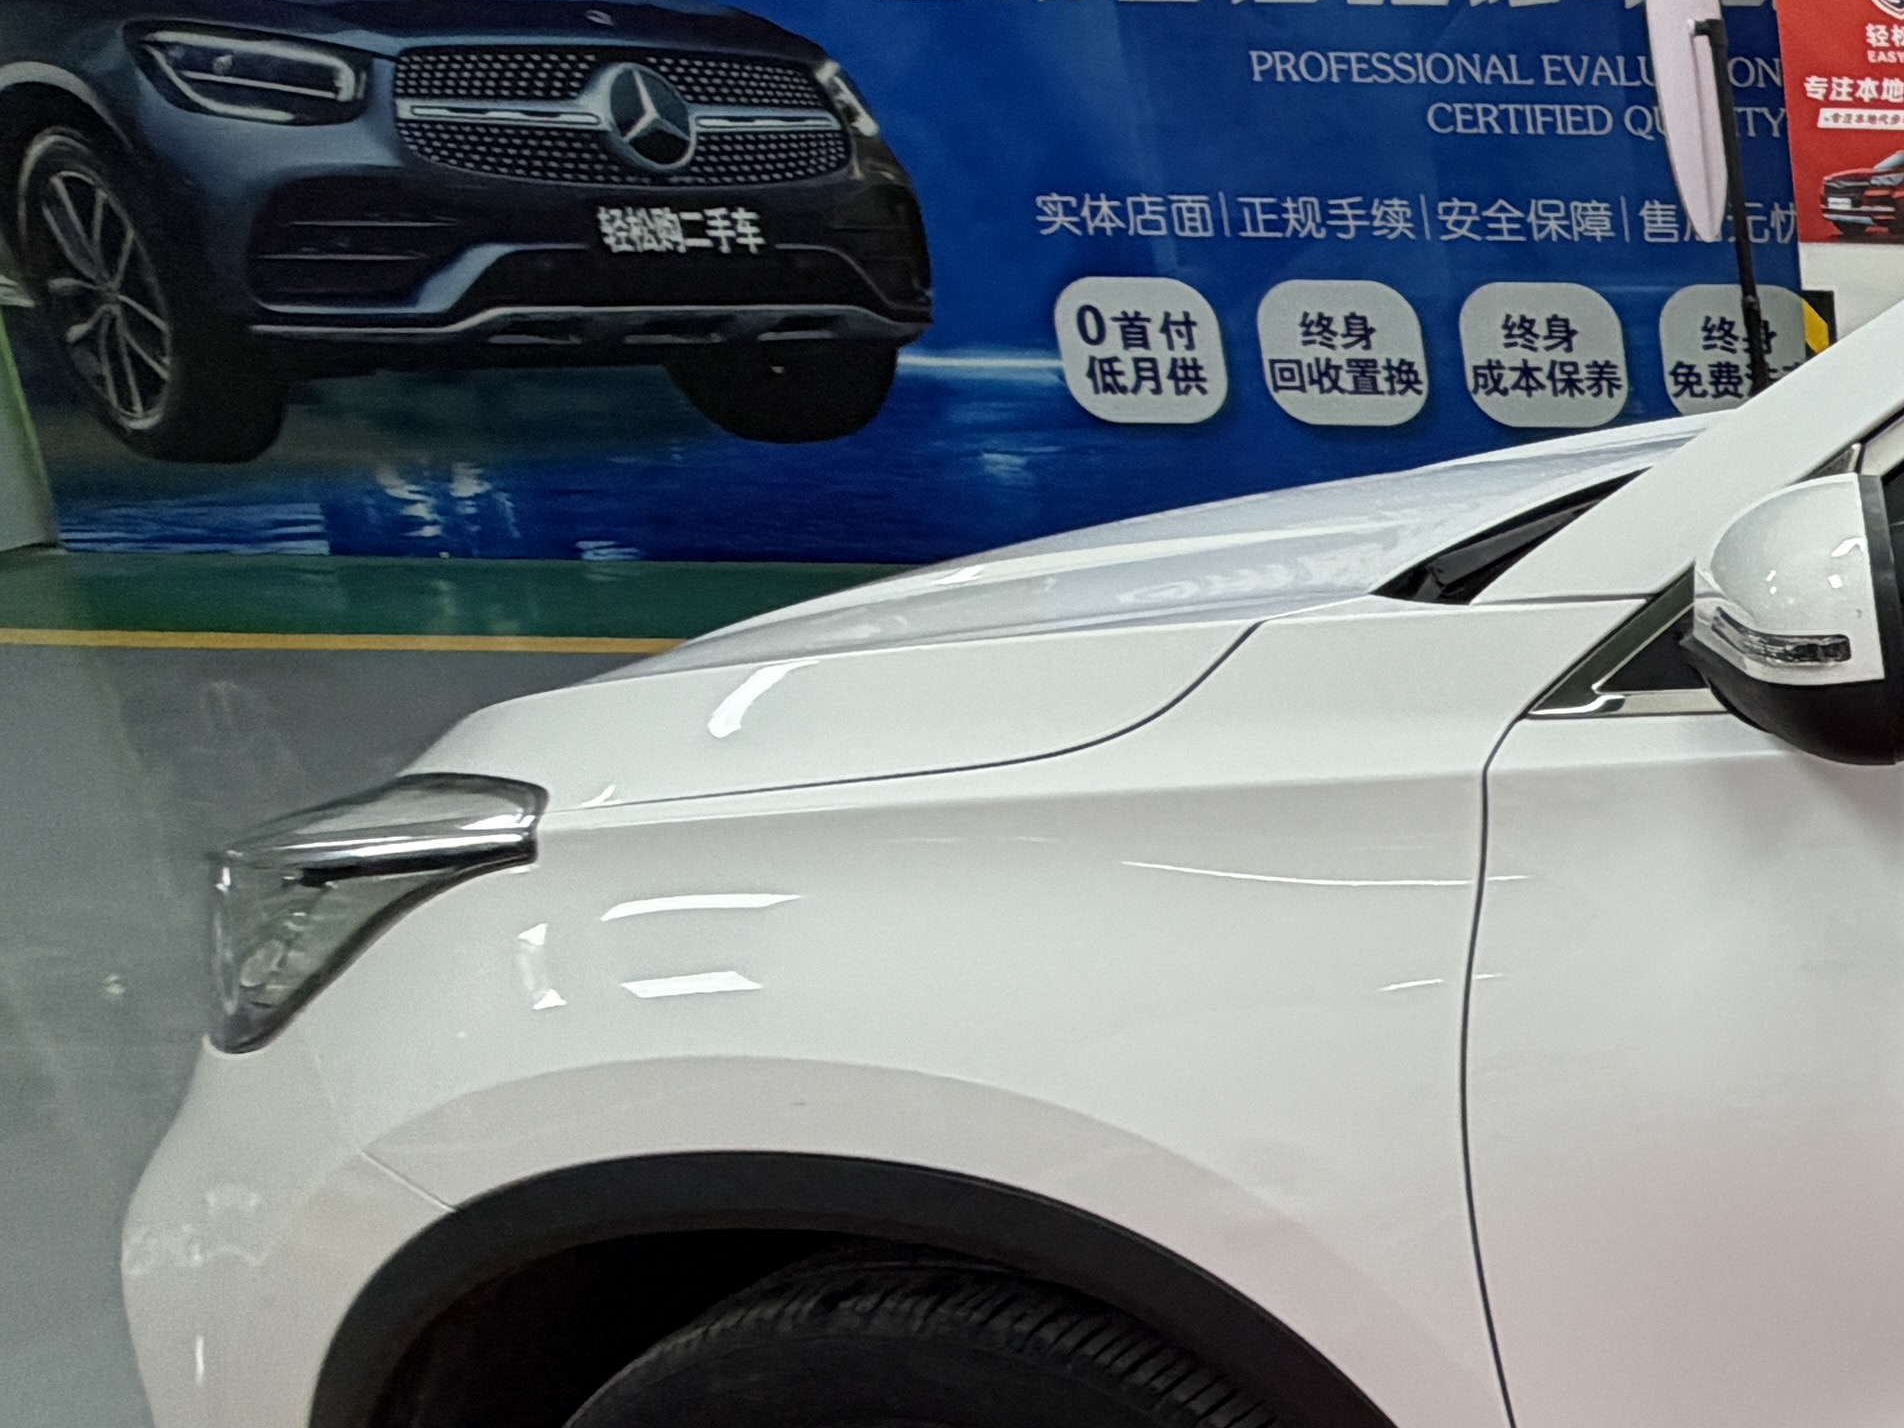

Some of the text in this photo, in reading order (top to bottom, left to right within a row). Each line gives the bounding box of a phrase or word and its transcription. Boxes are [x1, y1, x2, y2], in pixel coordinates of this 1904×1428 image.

[1248, 49, 1534, 86] PROFESSIONAL
[1426, 101, 1614, 138] CERTIFIED
[597, 206, 767, 254] 轻松购二手车
[1035, 192, 1216, 237] 实体店面
[1236, 195, 1413, 240] 正规手续
[1438, 198, 1615, 242] 安全保障
[1077, 305, 1197, 351] 0首付
[1300, 312, 1376, 352] 终身
[1501, 313, 1578, 353] 终身
[1086, 357, 1208, 397] 低月供
[1270, 358, 1424, 397] 回收置换
[1471, 359, 1623, 400] 成本保养
